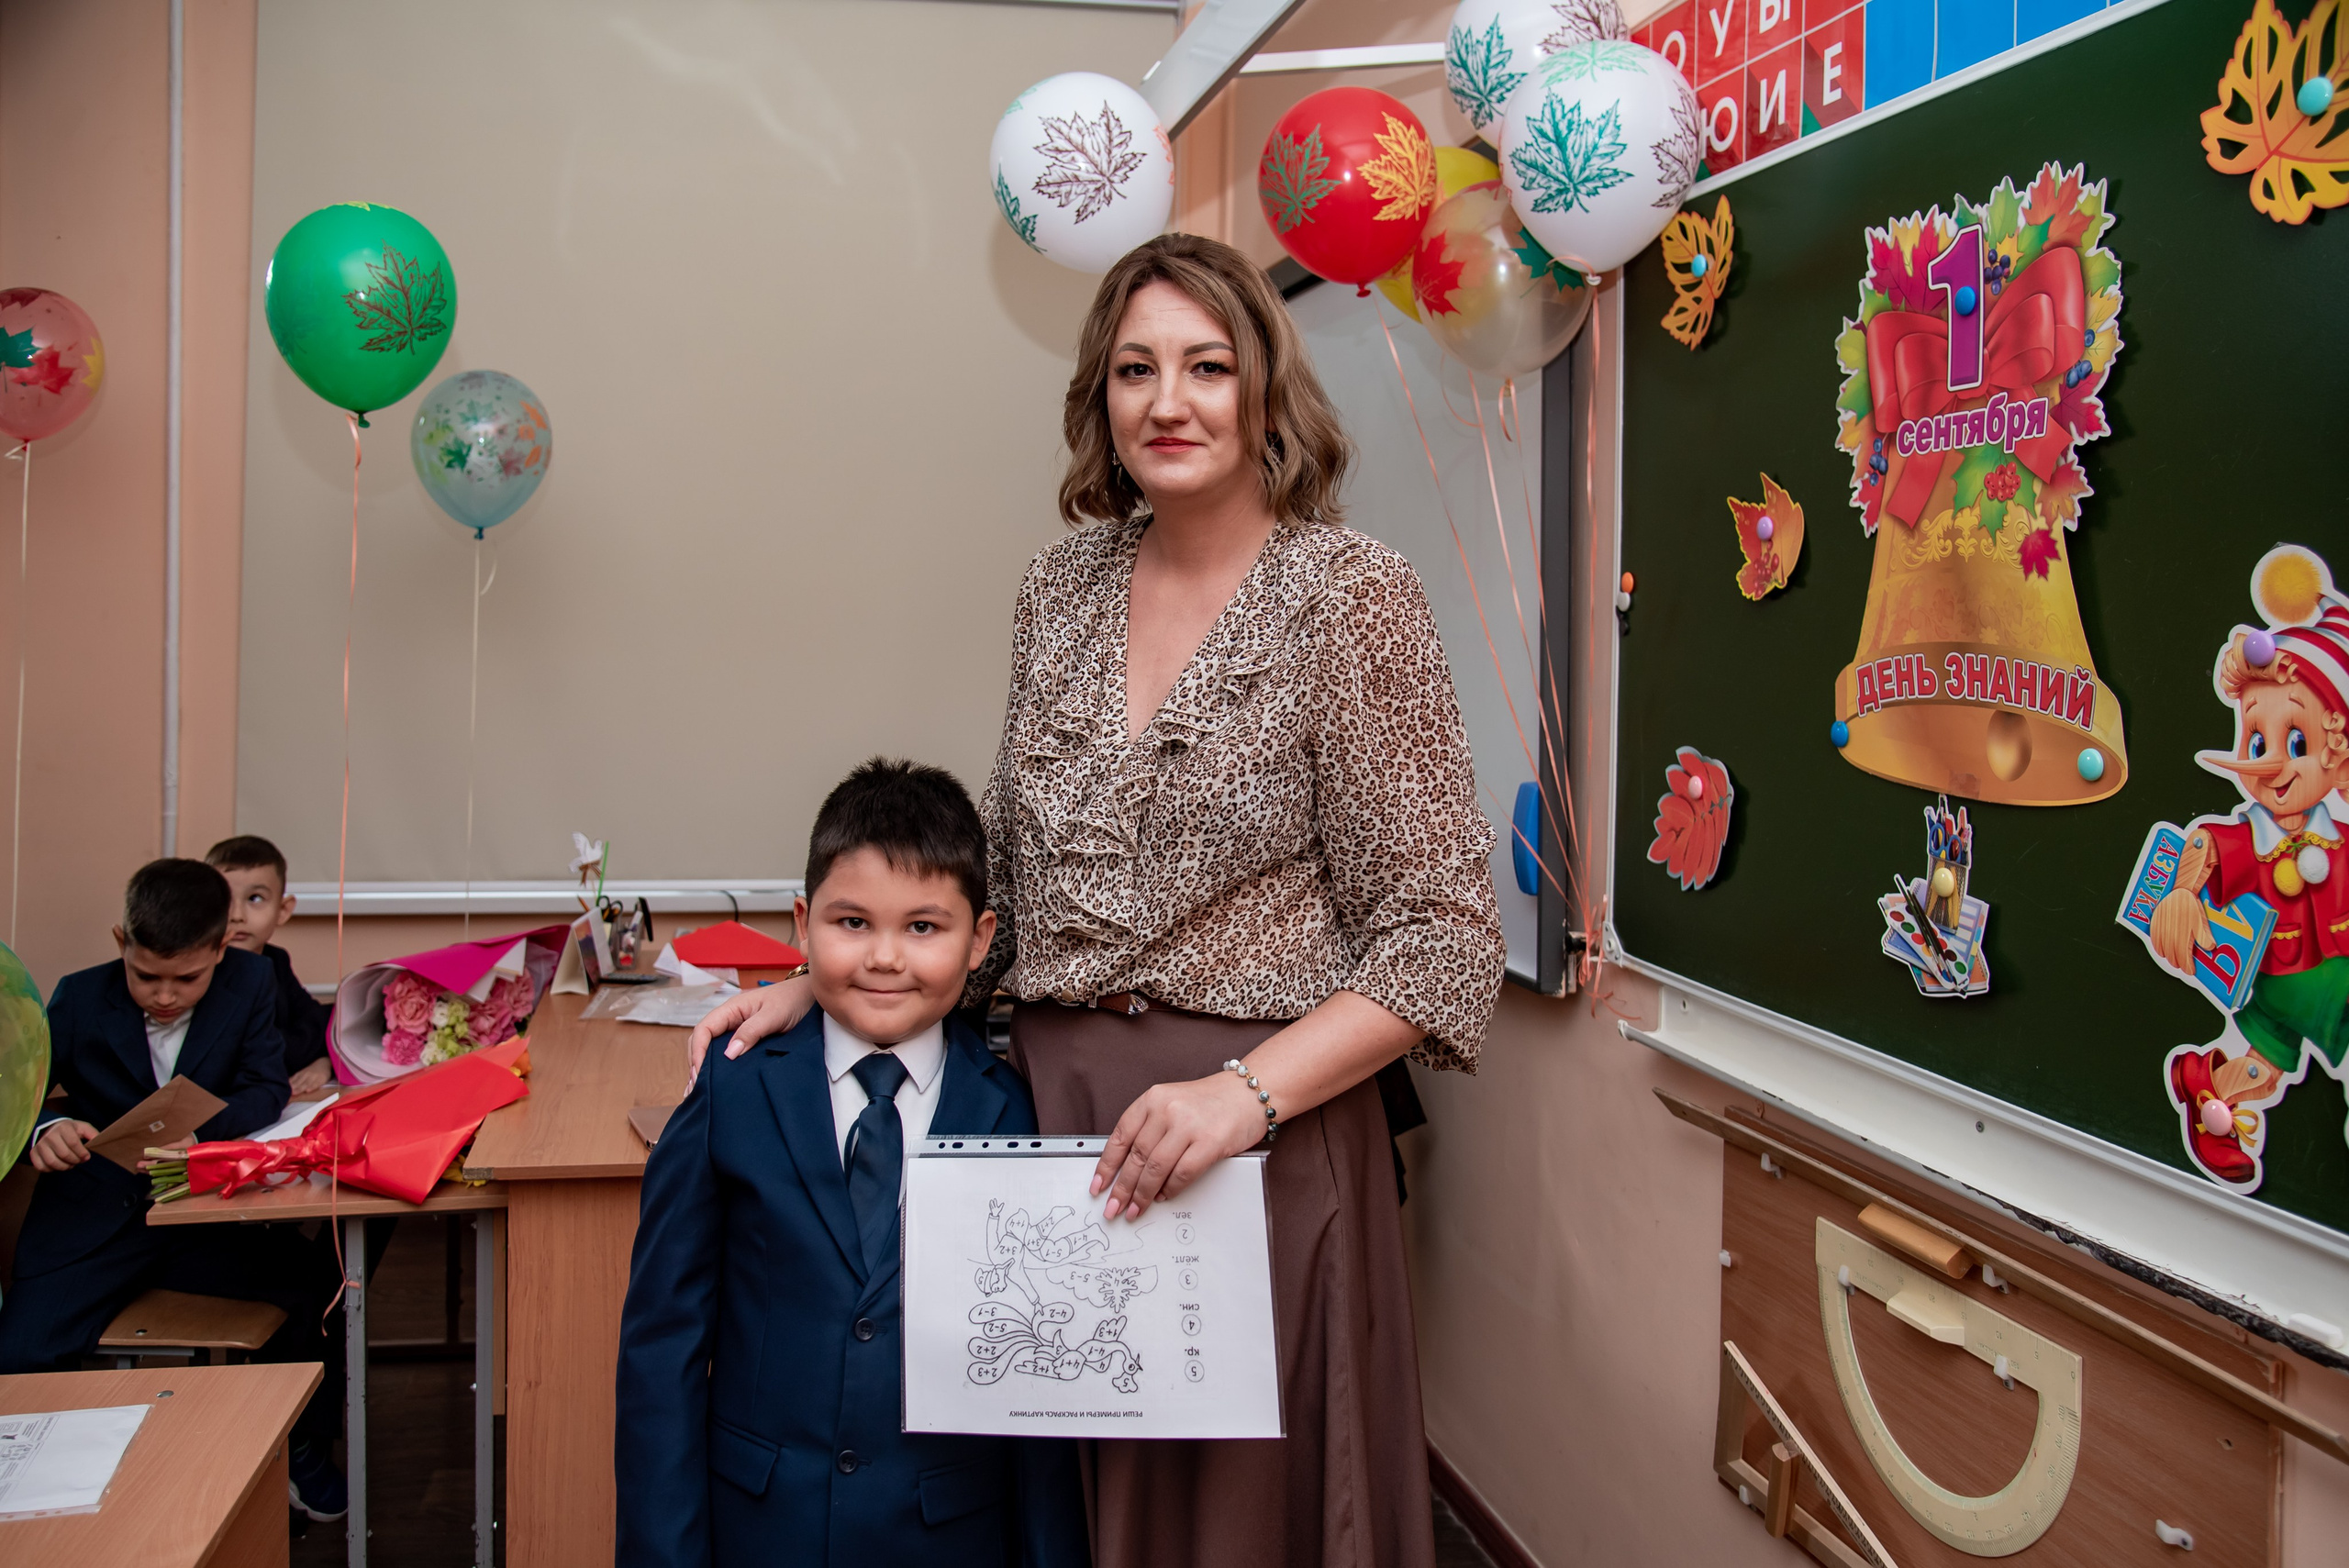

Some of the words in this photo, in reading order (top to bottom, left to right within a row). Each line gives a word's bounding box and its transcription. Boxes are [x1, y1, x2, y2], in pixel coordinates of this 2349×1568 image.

[1709, 0, 1734, 58] У
[1699, 96, 1738, 161] Ю
[1759, 69, 1787, 134] И
[1822, 41, 1842, 106] Е
[1928, 224, 1984, 392] 1
[1897, 392, 2049, 457] сентября
[1855, 652, 1938, 718] ДЕНЬ
[1944, 651, 2097, 732] ЗНАНИЙ
[2129, 837, 2179, 925] АЗБУКА
[1172, 1211, 1192, 1219] зел.
[1009, 1218, 1026, 1228] 1+4
[1182, 1229, 1187, 1240] 2
[1027, 1238, 1041, 1247] 3+1
[999, 1245, 1018, 1255] 3+2
[1172, 1255, 1199, 1265] жёлт.
[1185, 1274, 1191, 1284] 3
[1179, 1303, 1199, 1311] син.
[1189, 1320, 1195, 1329] 4
[1099, 1328, 1118, 1338] 1+3
[976, 1345, 996, 1354] 2+2
[1056, 1346, 1063, 1354] 3
[1185, 1346, 1200, 1356] кр.
[1060, 1358, 1080, 1368] 4+1
[1100, 1362, 1106, 1370] 4
[977, 1367, 997, 1376] 2+3
[1032, 1364, 1049, 1373] 1+2
[1191, 1366, 1197, 1376] 5
[1123, 1378, 1129, 1386] 5
